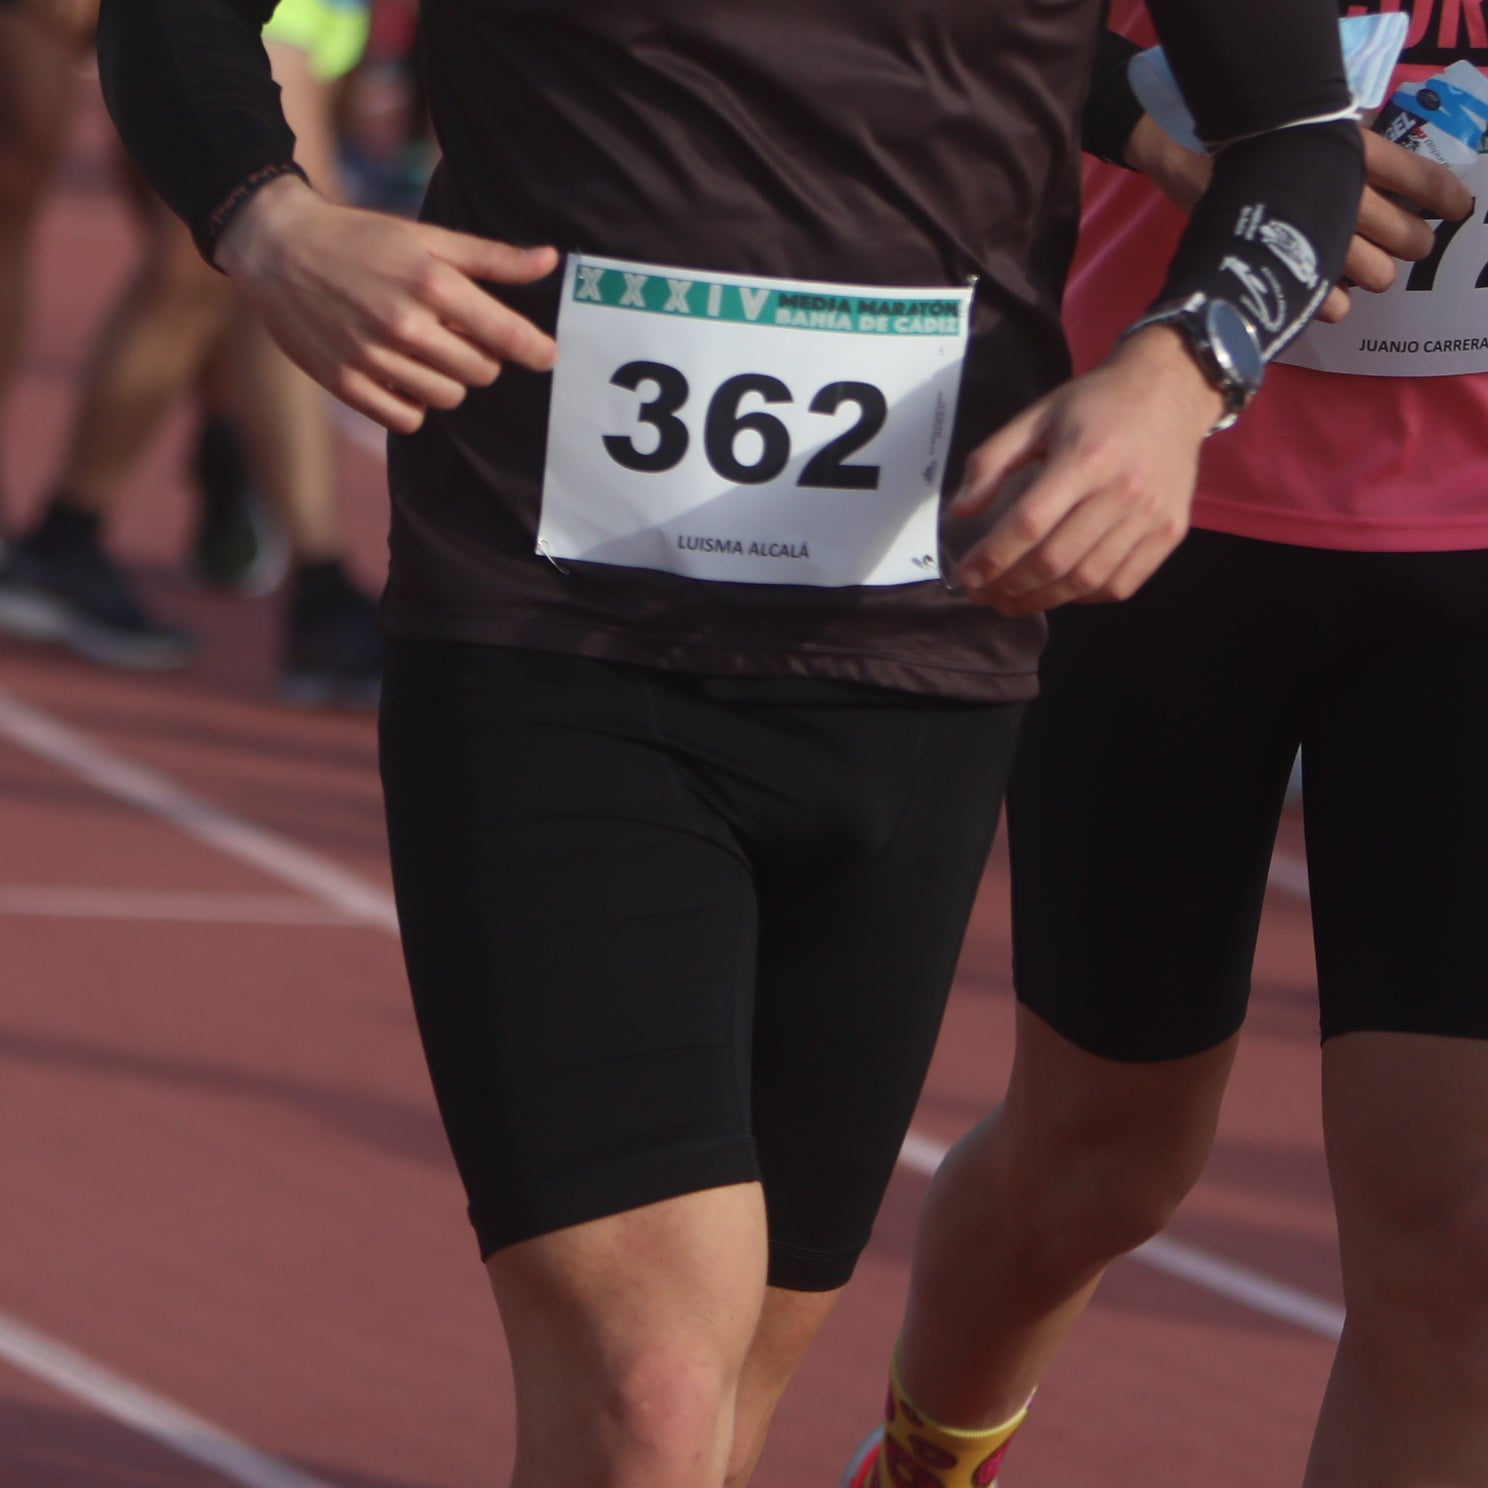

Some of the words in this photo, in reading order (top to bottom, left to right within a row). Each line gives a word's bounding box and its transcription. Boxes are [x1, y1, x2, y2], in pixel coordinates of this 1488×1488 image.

[778, 293, 852, 313] MEDIA
[858, 300, 958, 317] MARATÓN
[859, 316, 889, 332] DE
[893, 314, 960, 334] CÁDIZ
[1359, 338, 1419, 353] JUANJO
[602, 360, 888, 490] 362
[678, 535, 743, 555] LUISMA
[749, 540, 810, 559] ALCALÁ
